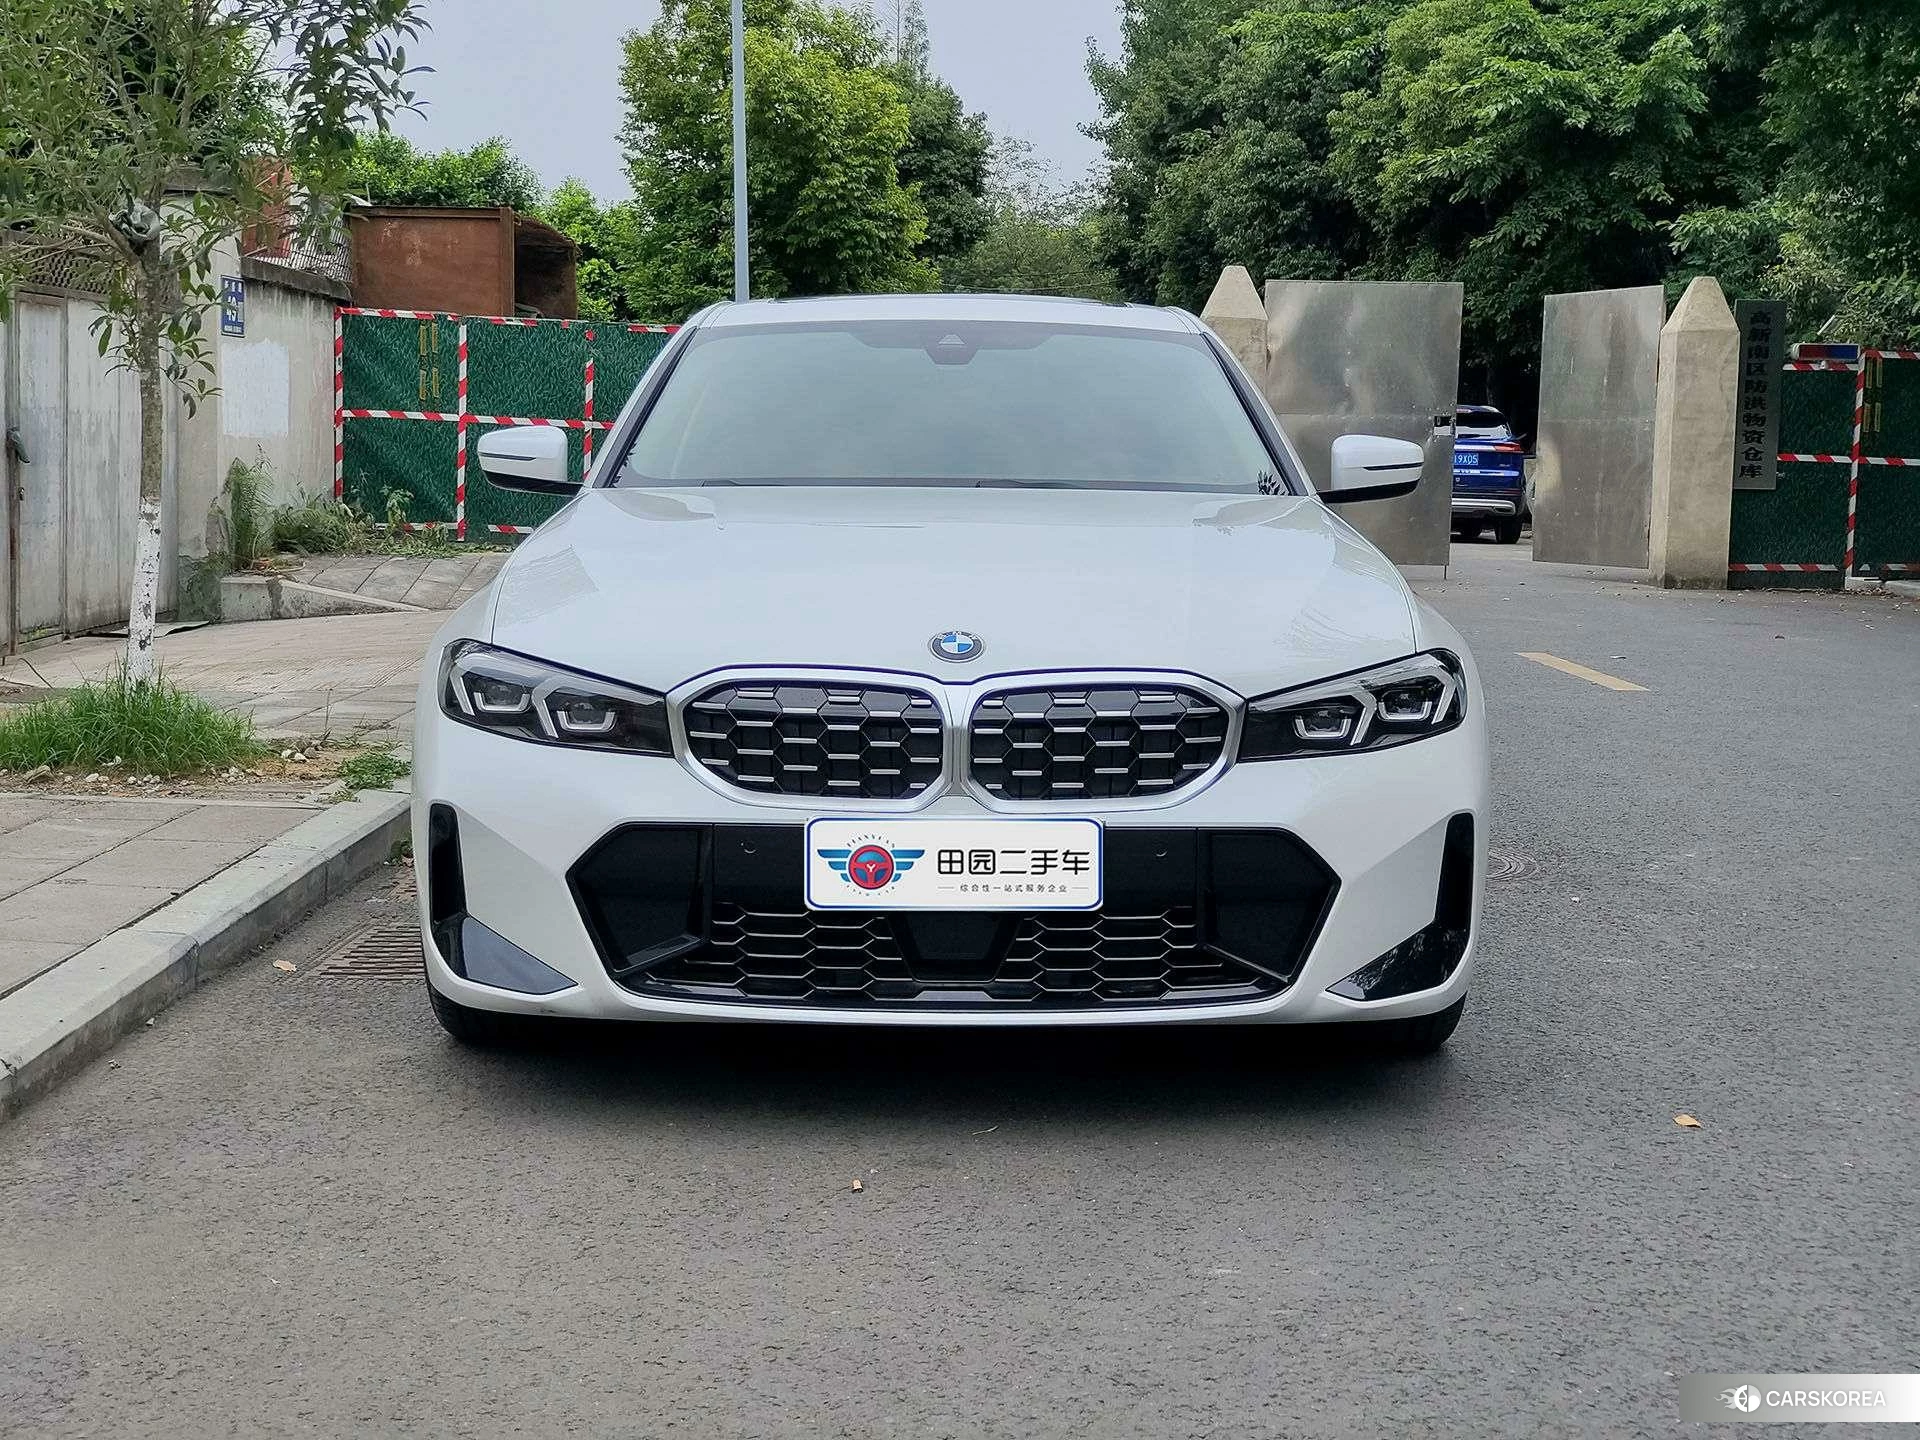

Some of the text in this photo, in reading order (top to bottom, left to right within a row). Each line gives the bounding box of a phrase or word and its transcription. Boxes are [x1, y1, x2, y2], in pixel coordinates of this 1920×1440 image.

[937, 848, 1090, 876] 田园二手车
[959, 883, 1068, 893] 综合性一站式服务企业
